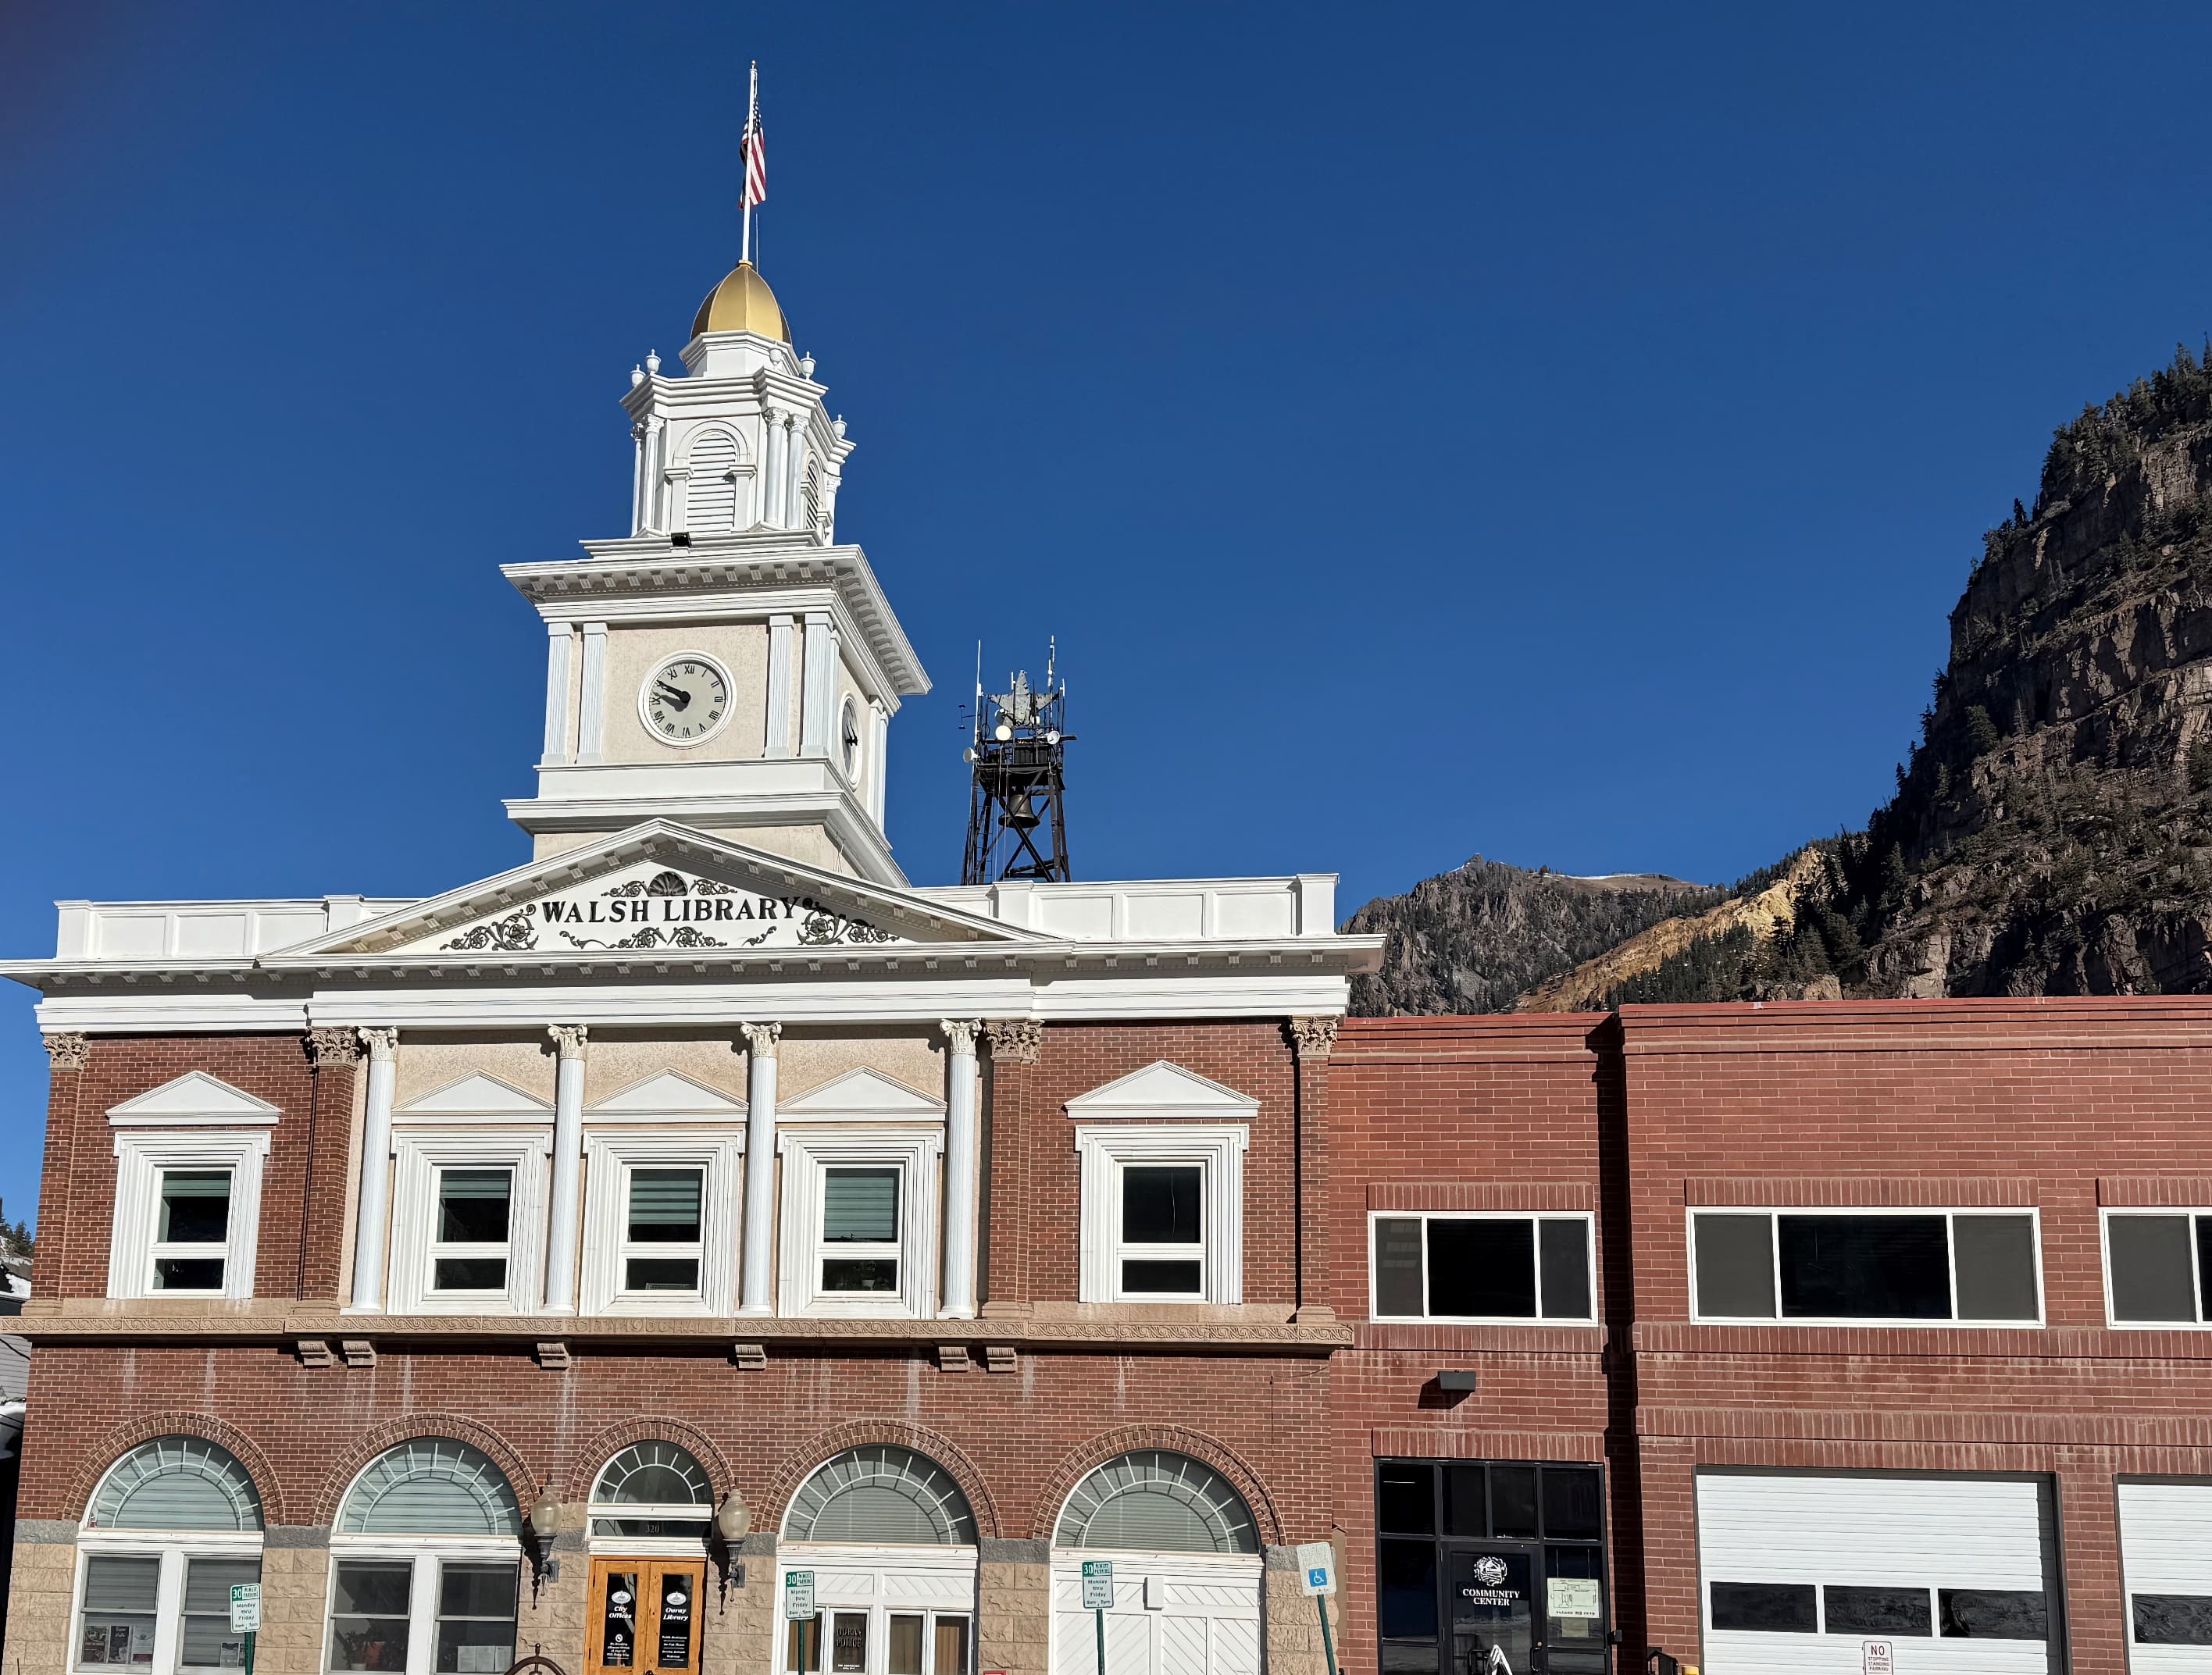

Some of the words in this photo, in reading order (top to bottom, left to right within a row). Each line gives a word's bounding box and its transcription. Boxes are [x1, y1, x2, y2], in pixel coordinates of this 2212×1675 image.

[542, 900, 650, 923] WALSH
[663, 896, 801, 921] LIBRARY
[645, 1524, 660, 1533] 320
[1083, 1564, 1094, 1574] 30
[787, 1574, 797, 1584] 30
[232, 1588, 242, 1598] 30
[1462, 1588, 1520, 1598] COMMUNITY
[1473, 1597, 1510, 1606] CENTER
[837, 1637, 862, 1648] POLICE
[1871, 1645, 1885, 1655] NO
